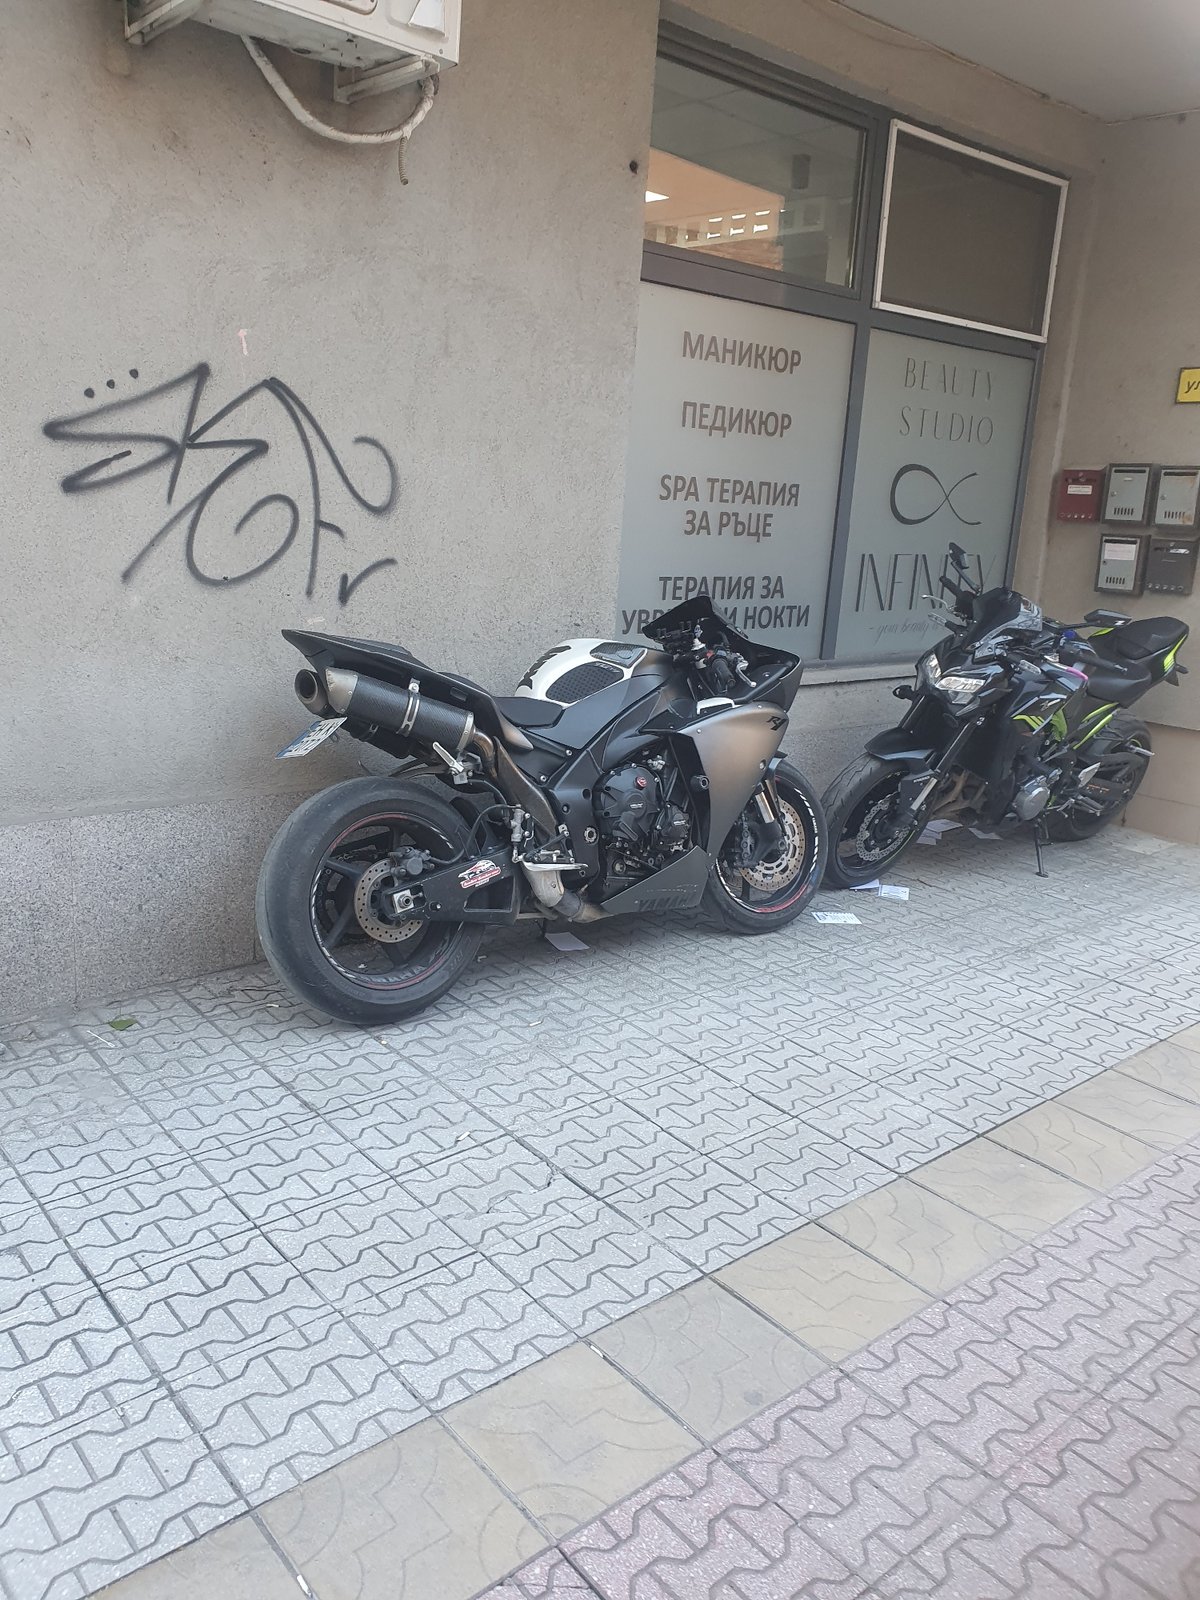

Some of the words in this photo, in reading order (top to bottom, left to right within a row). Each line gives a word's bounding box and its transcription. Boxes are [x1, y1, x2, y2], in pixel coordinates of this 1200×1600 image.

[682, 330, 801, 375] МАНИКЮР
[904, 357, 995, 401] BEAUTY
[681, 401, 793, 438] ПЕДИКЮР
[899, 405, 994, 445] STUDIO
[659, 474, 700, 502] SPA
[706, 477, 801, 507] ТЕРАПИЯ
[683, 509, 711, 536] ЗА
[718, 511, 774, 543] РЪЦЕ
[658, 575, 756, 601] ТЕРАПИЯ
[760, 575, 785, 599] ЗА
[743, 604, 811, 630] НОКТИ
